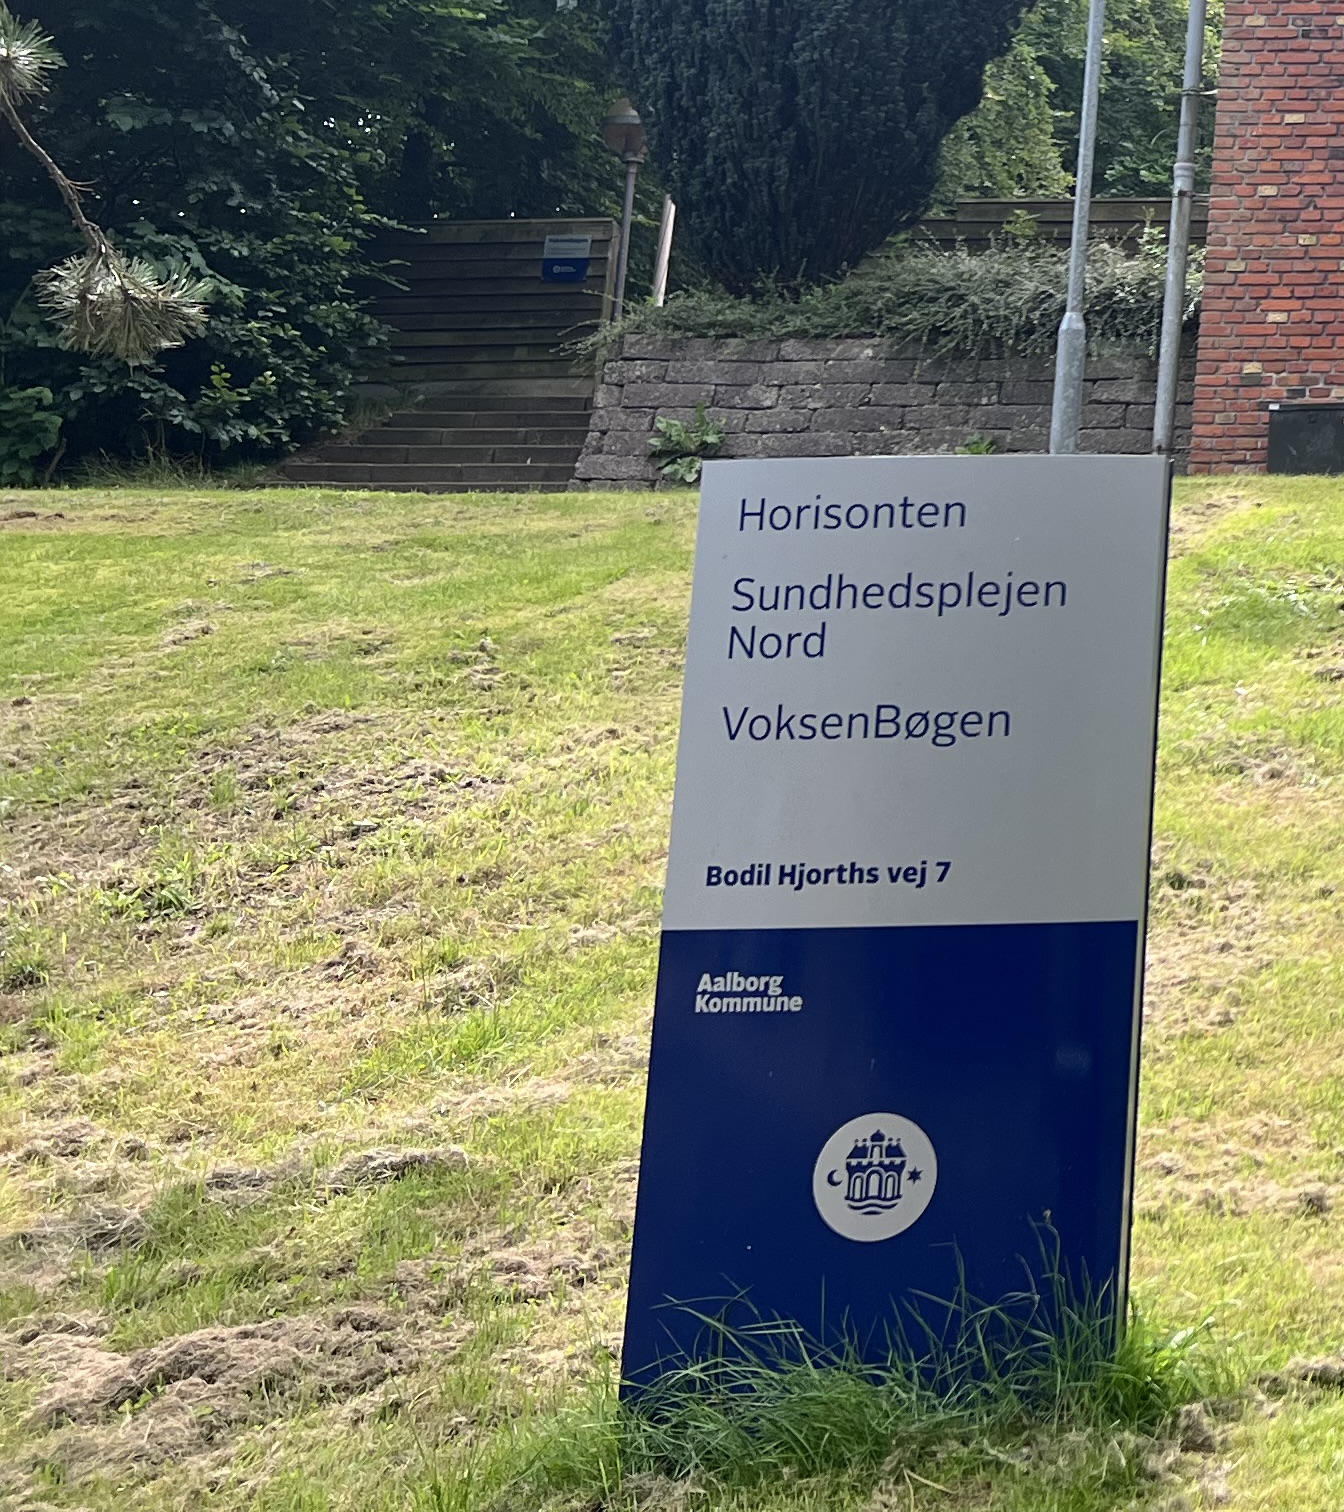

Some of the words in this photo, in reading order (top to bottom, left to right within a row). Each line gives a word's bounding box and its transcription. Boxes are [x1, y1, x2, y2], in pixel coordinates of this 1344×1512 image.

[739, 494, 967, 532] Horisonten
[731, 571, 1068, 618] Sundhedsplejen
[727, 621, 827, 660] Nord
[722, 702, 1012, 748] VoksenBøgen
[705, 863, 772, 887] Bodil
[778, 861, 880, 892] Hjorths
[887, 859, 928, 889] vej
[935, 860, 952, 884] 7
[697, 971, 784, 996] Aalborg
[694, 994, 803, 1014] Kommune
